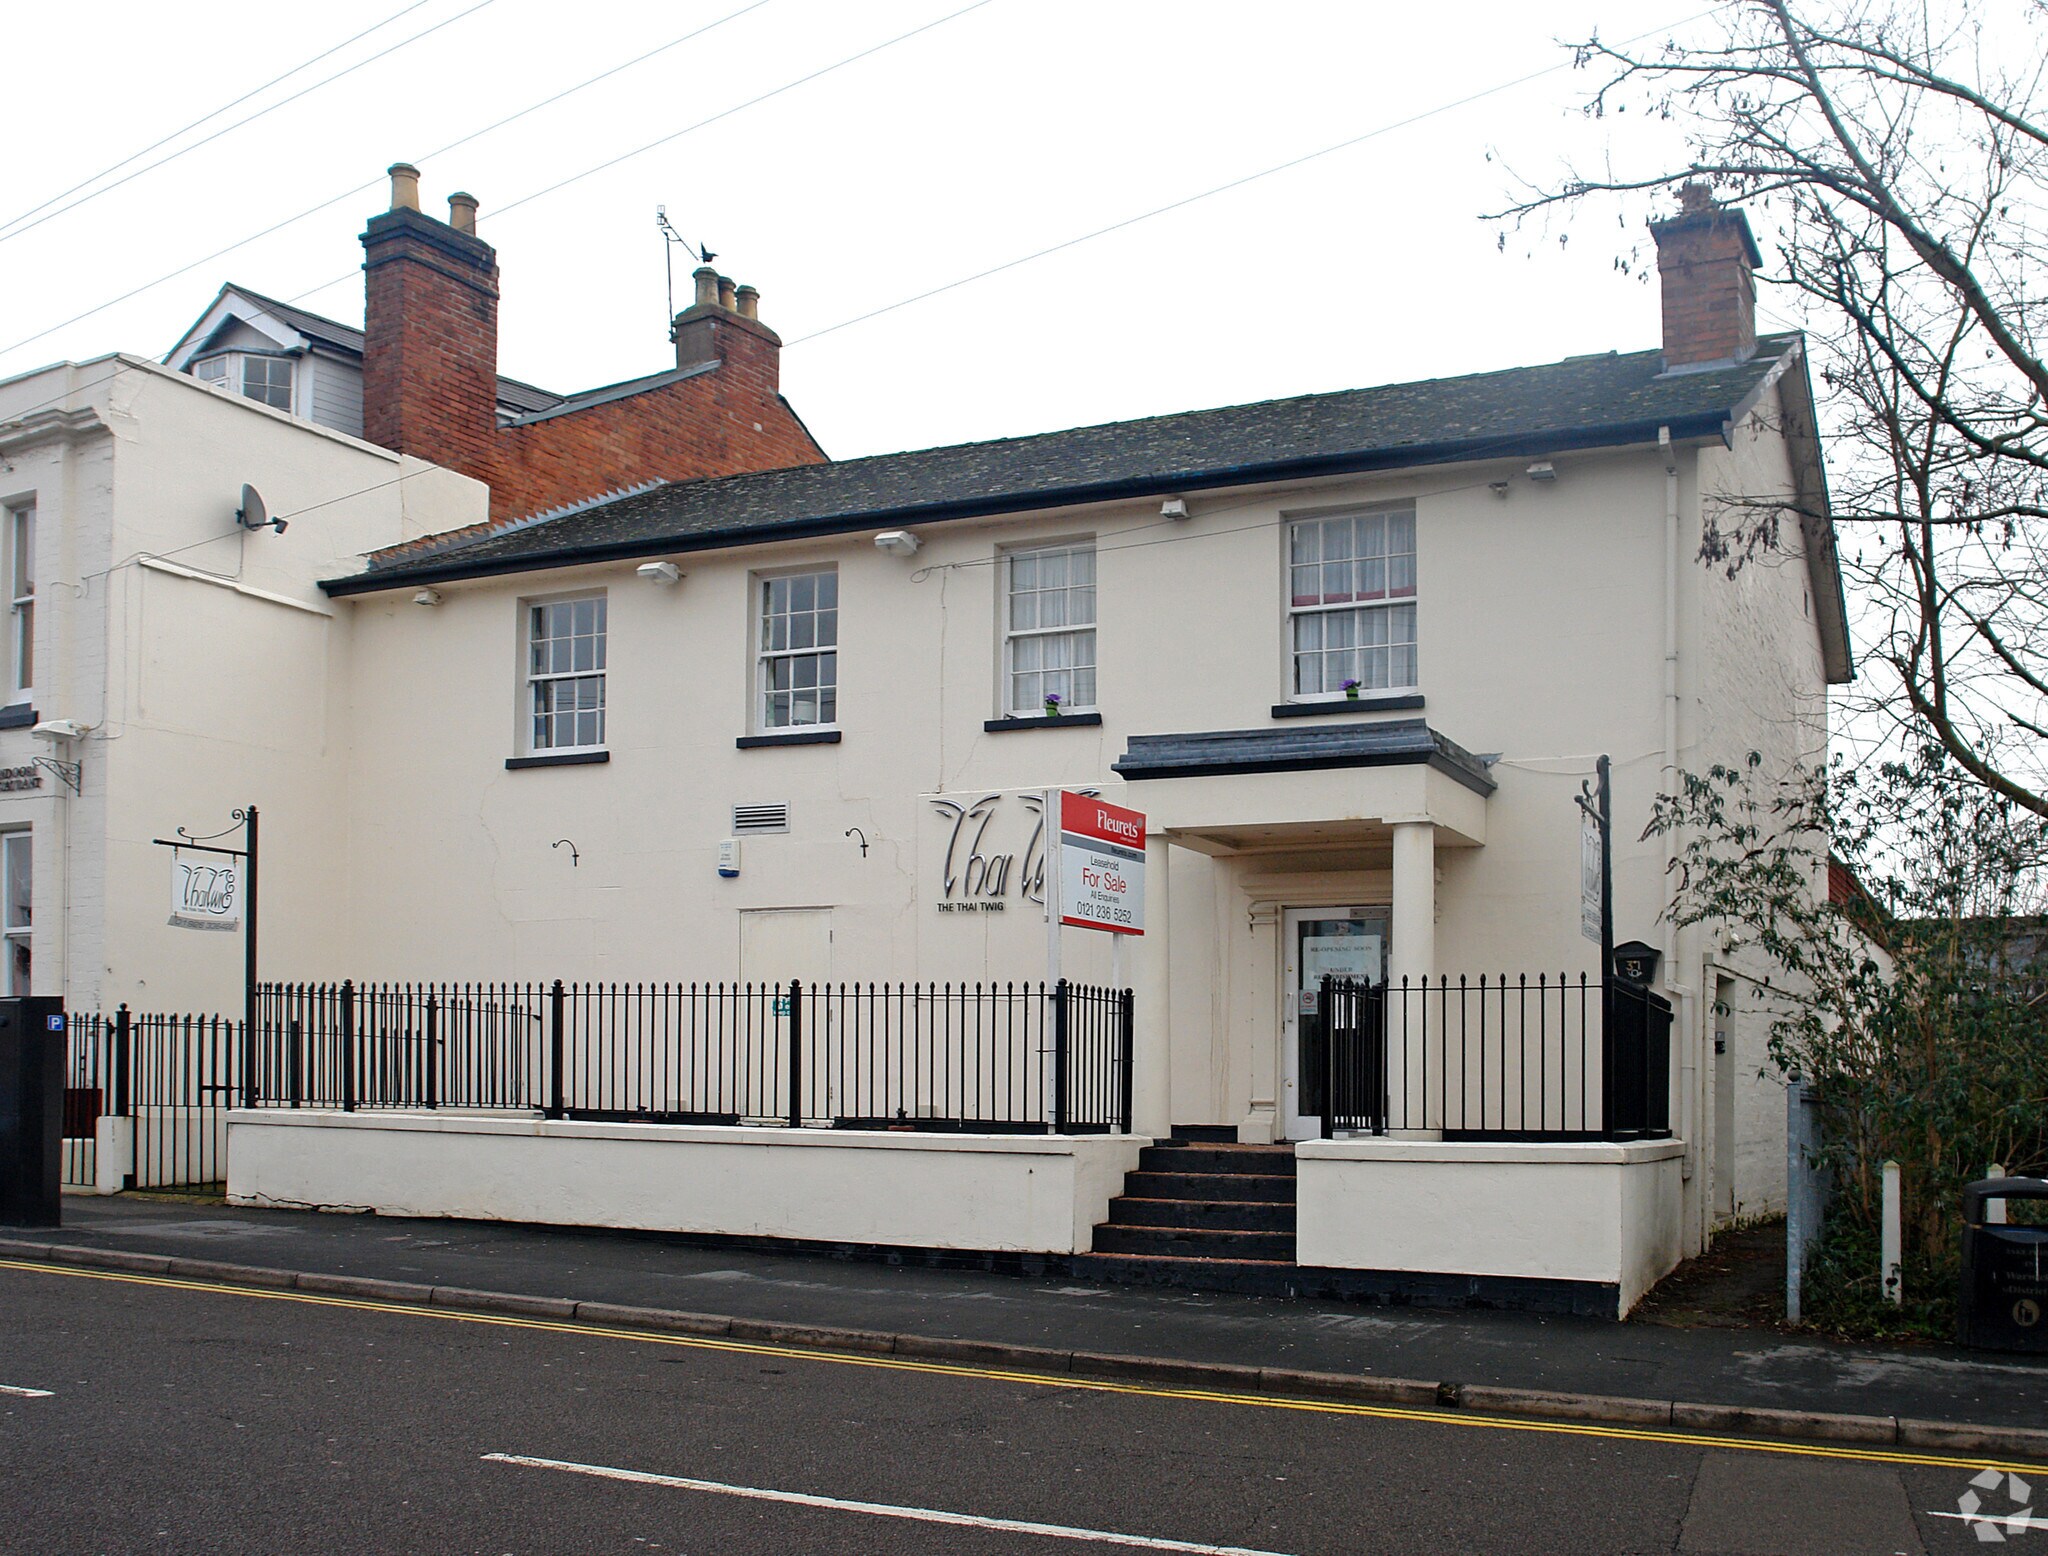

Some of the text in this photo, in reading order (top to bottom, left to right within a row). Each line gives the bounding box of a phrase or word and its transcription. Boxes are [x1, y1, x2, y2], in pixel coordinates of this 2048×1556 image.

[1097, 809, 1138, 838] Fleurets
[1091, 855, 1120, 871] Leasehold
[1082, 868, 1127, 894] For Sale
[1098, 891, 1120, 904] Enquiries
[937, 902, 1004, 912] THE THAI TWIG
[1077, 901, 1132, 924] 0121 236 5252
[51, 1017, 61, 1029] P
